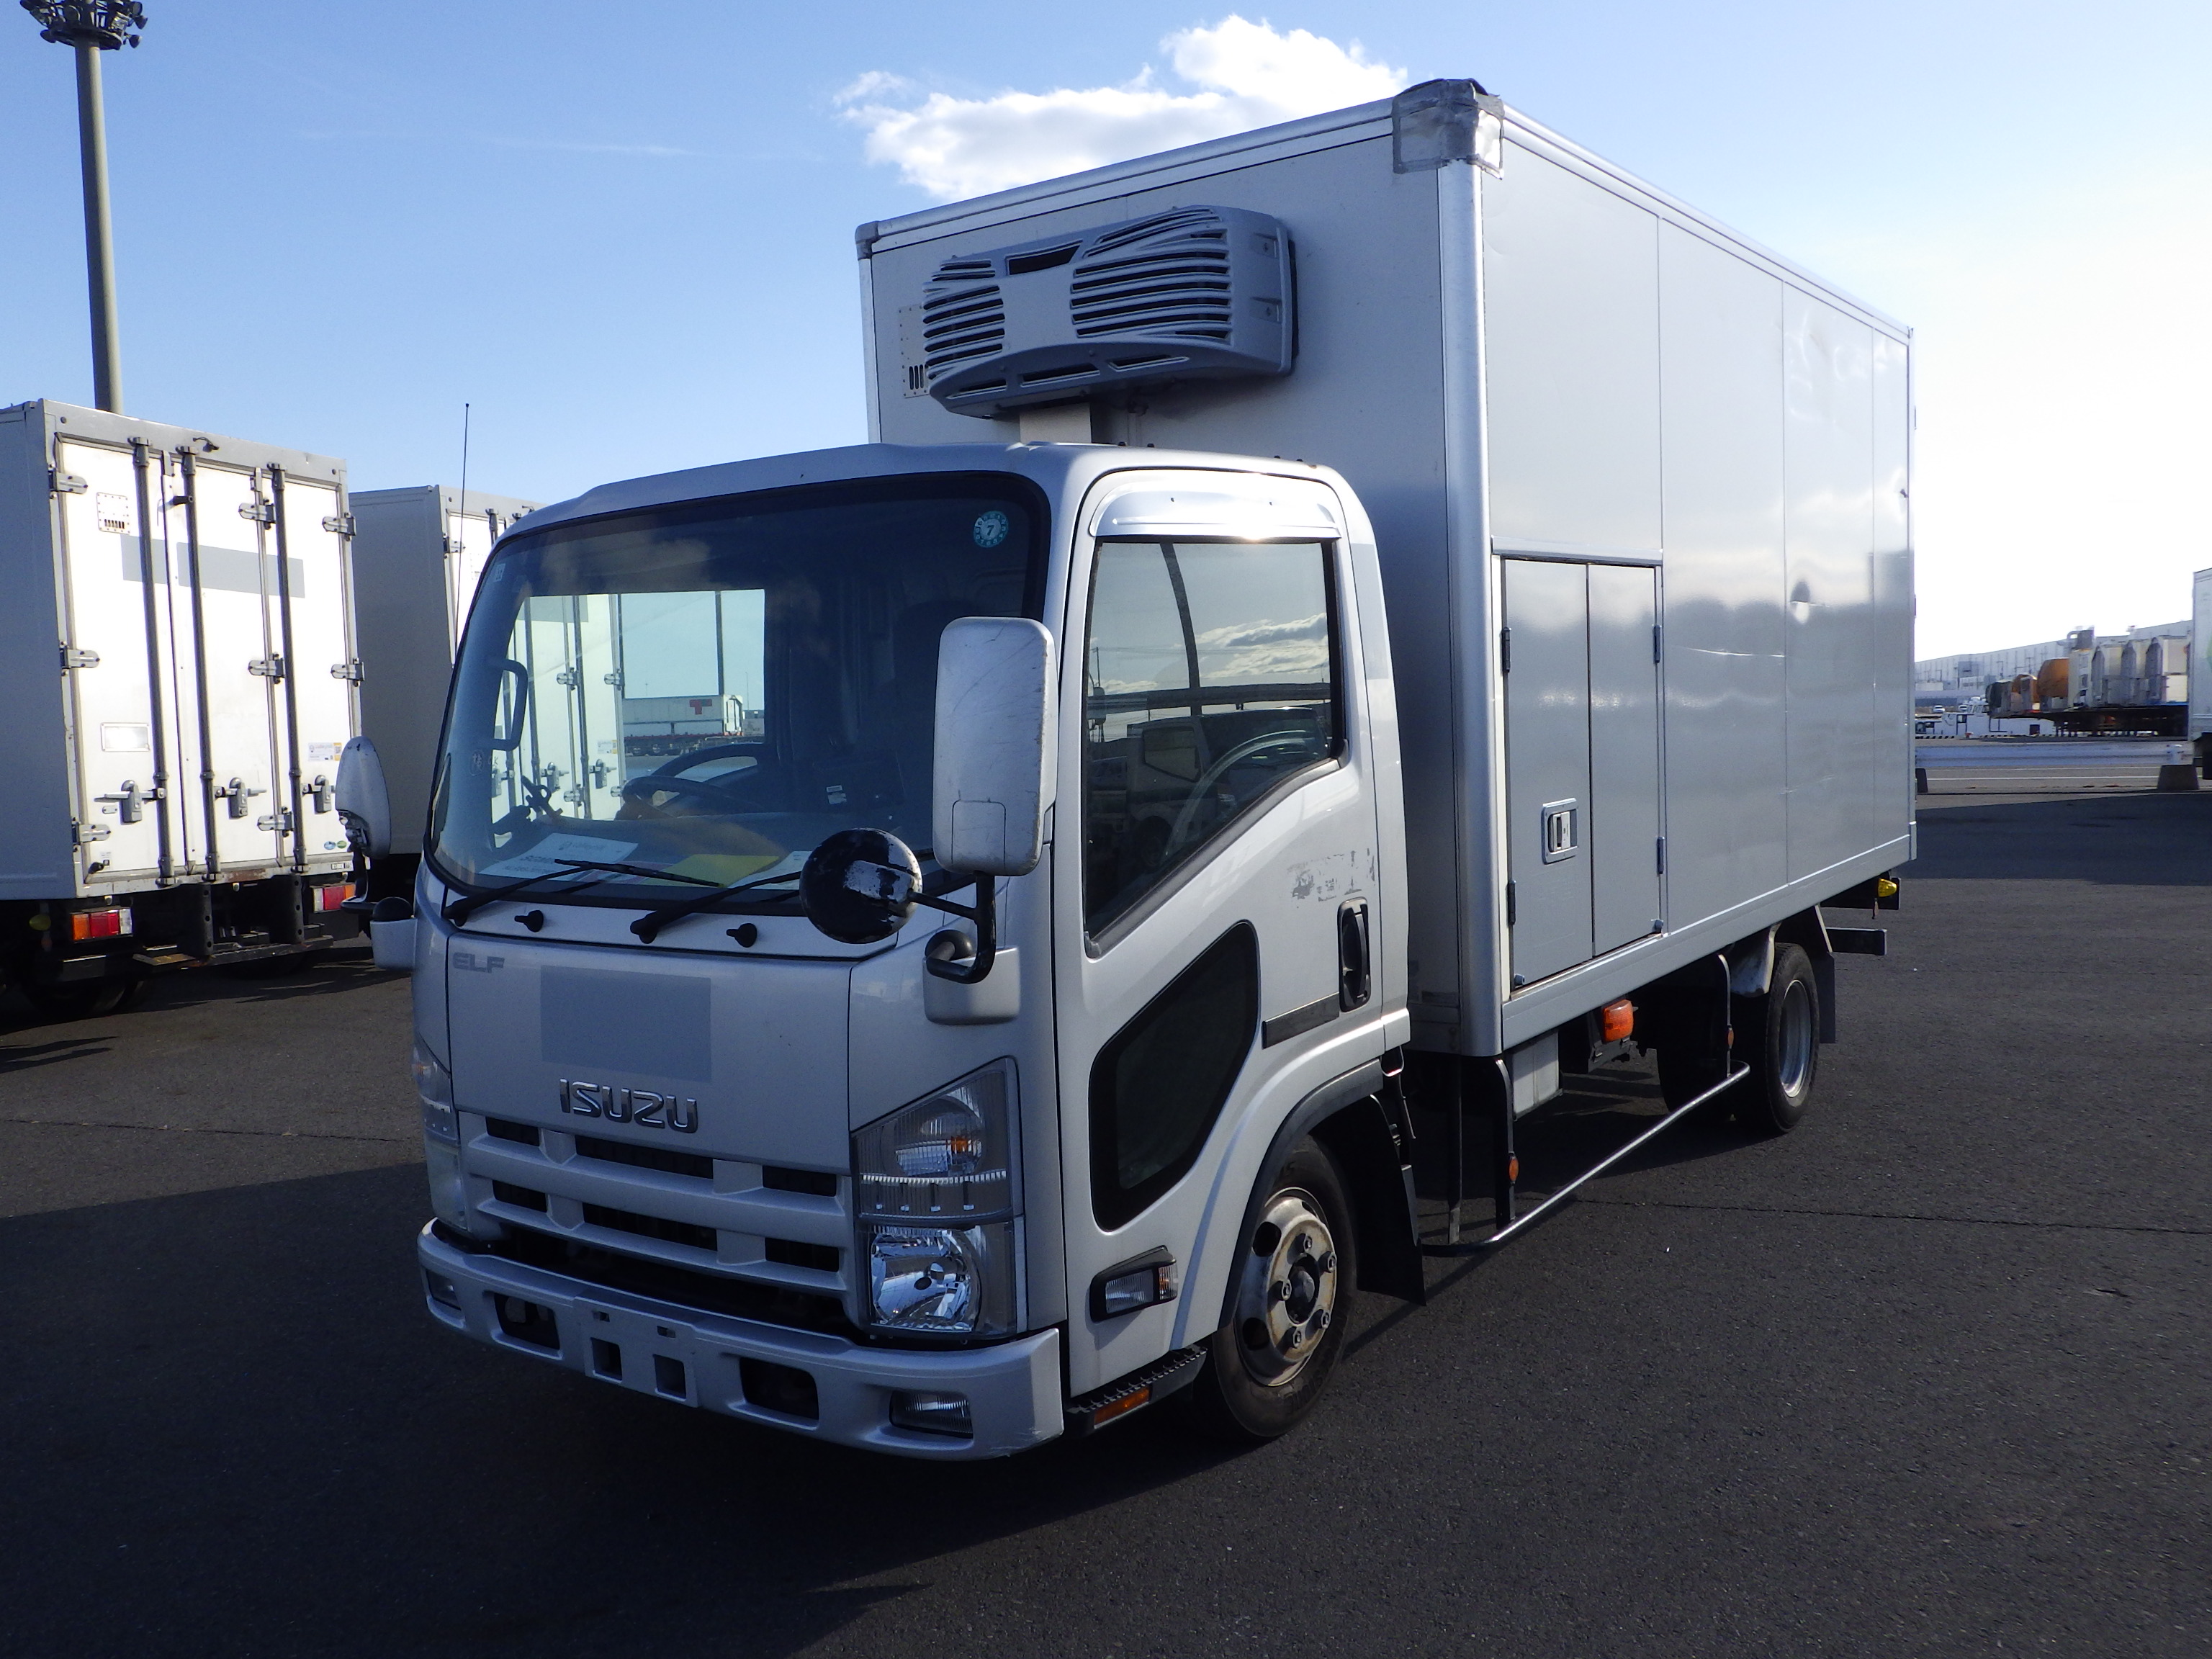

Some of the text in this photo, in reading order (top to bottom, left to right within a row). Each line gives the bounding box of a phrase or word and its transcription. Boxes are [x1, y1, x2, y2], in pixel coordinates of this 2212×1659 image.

[986, 524, 994, 536] 7
[452, 952, 505, 974] ELF
[559, 1078, 698, 1133] ISUZU
